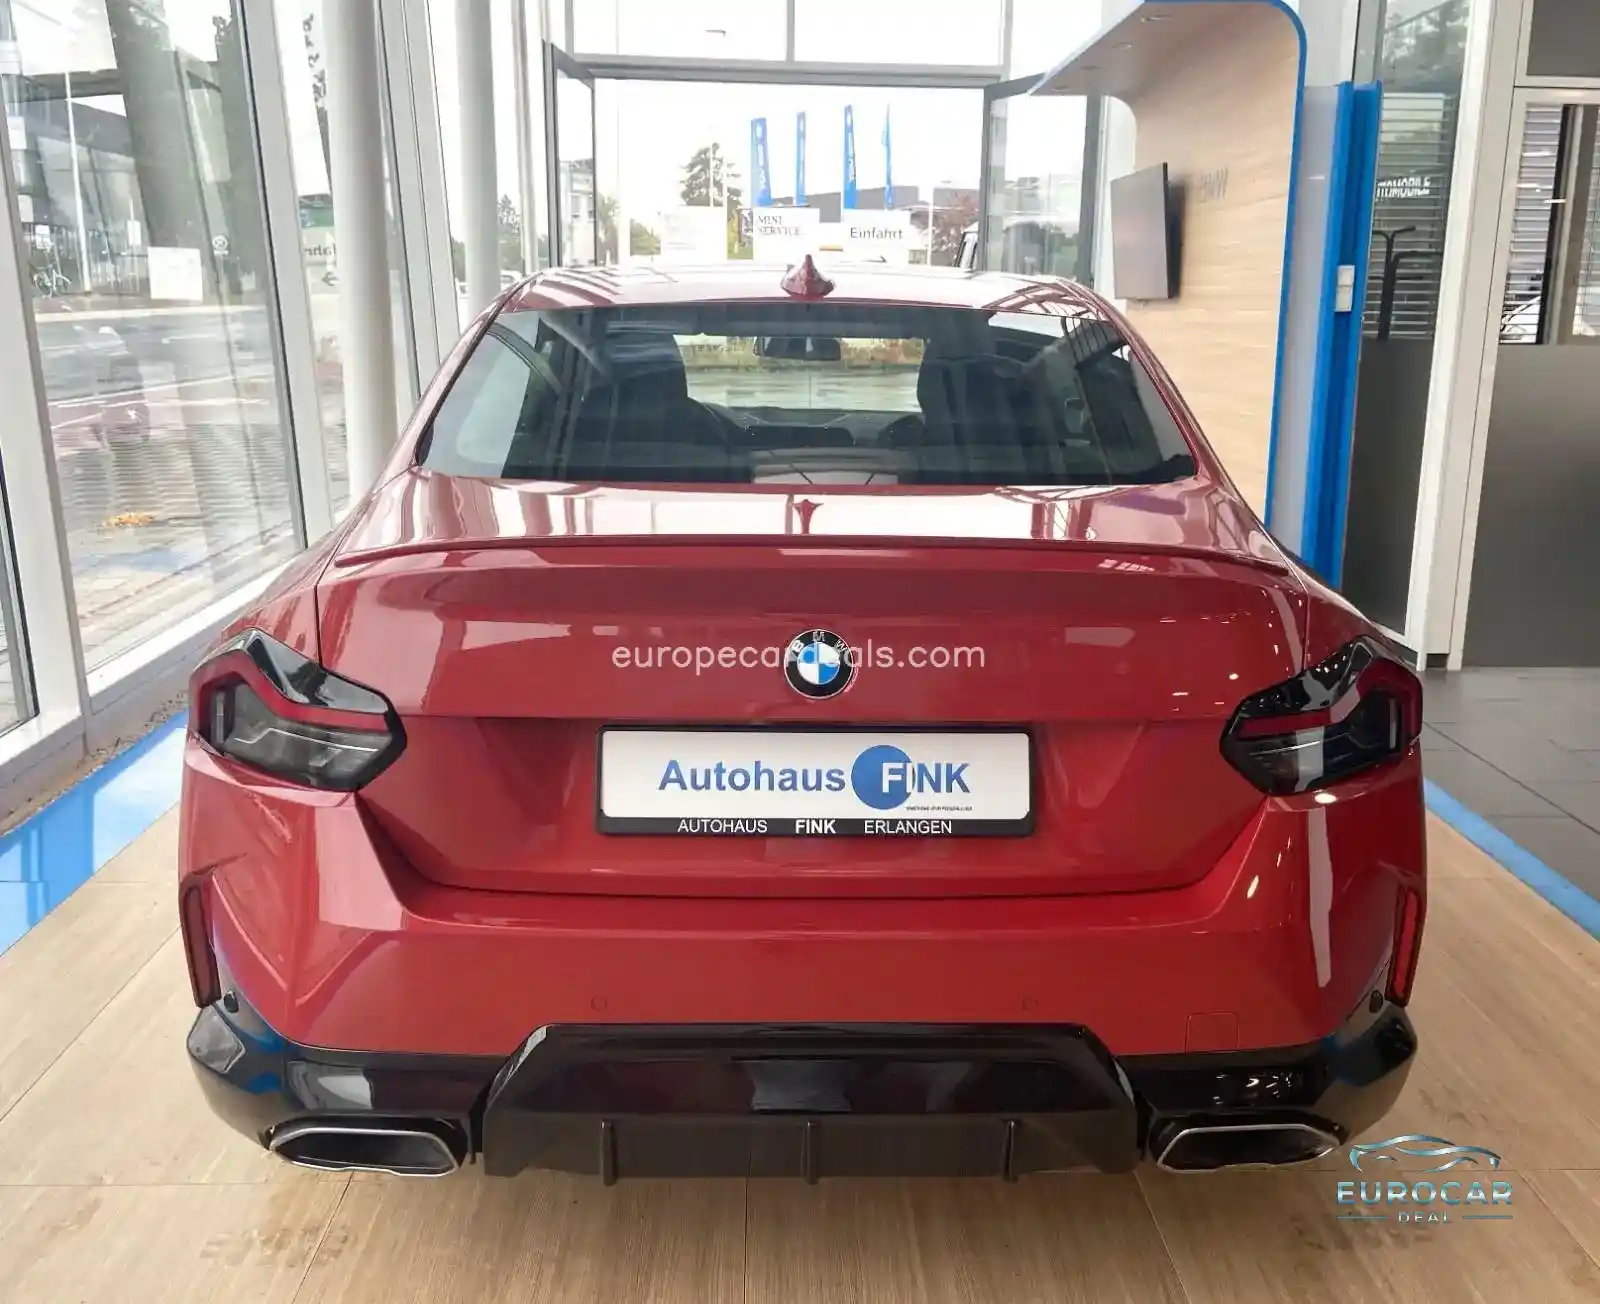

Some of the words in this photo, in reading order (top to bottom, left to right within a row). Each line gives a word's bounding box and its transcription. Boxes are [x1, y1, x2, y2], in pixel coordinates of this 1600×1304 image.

[758, 215, 782, 225] MINI
[758, 226, 800, 237] SERVICE
[850, 227, 903, 240] Einfahrt
[790, 630, 849, 654] BMW
[658, 759, 846, 792] Autohaus
[882, 762, 971, 794] FINK
[677, 819, 768, 834] AUTOHAUS
[795, 819, 837, 834] FINK
[864, 820, 953, 835] ERLANGEN
